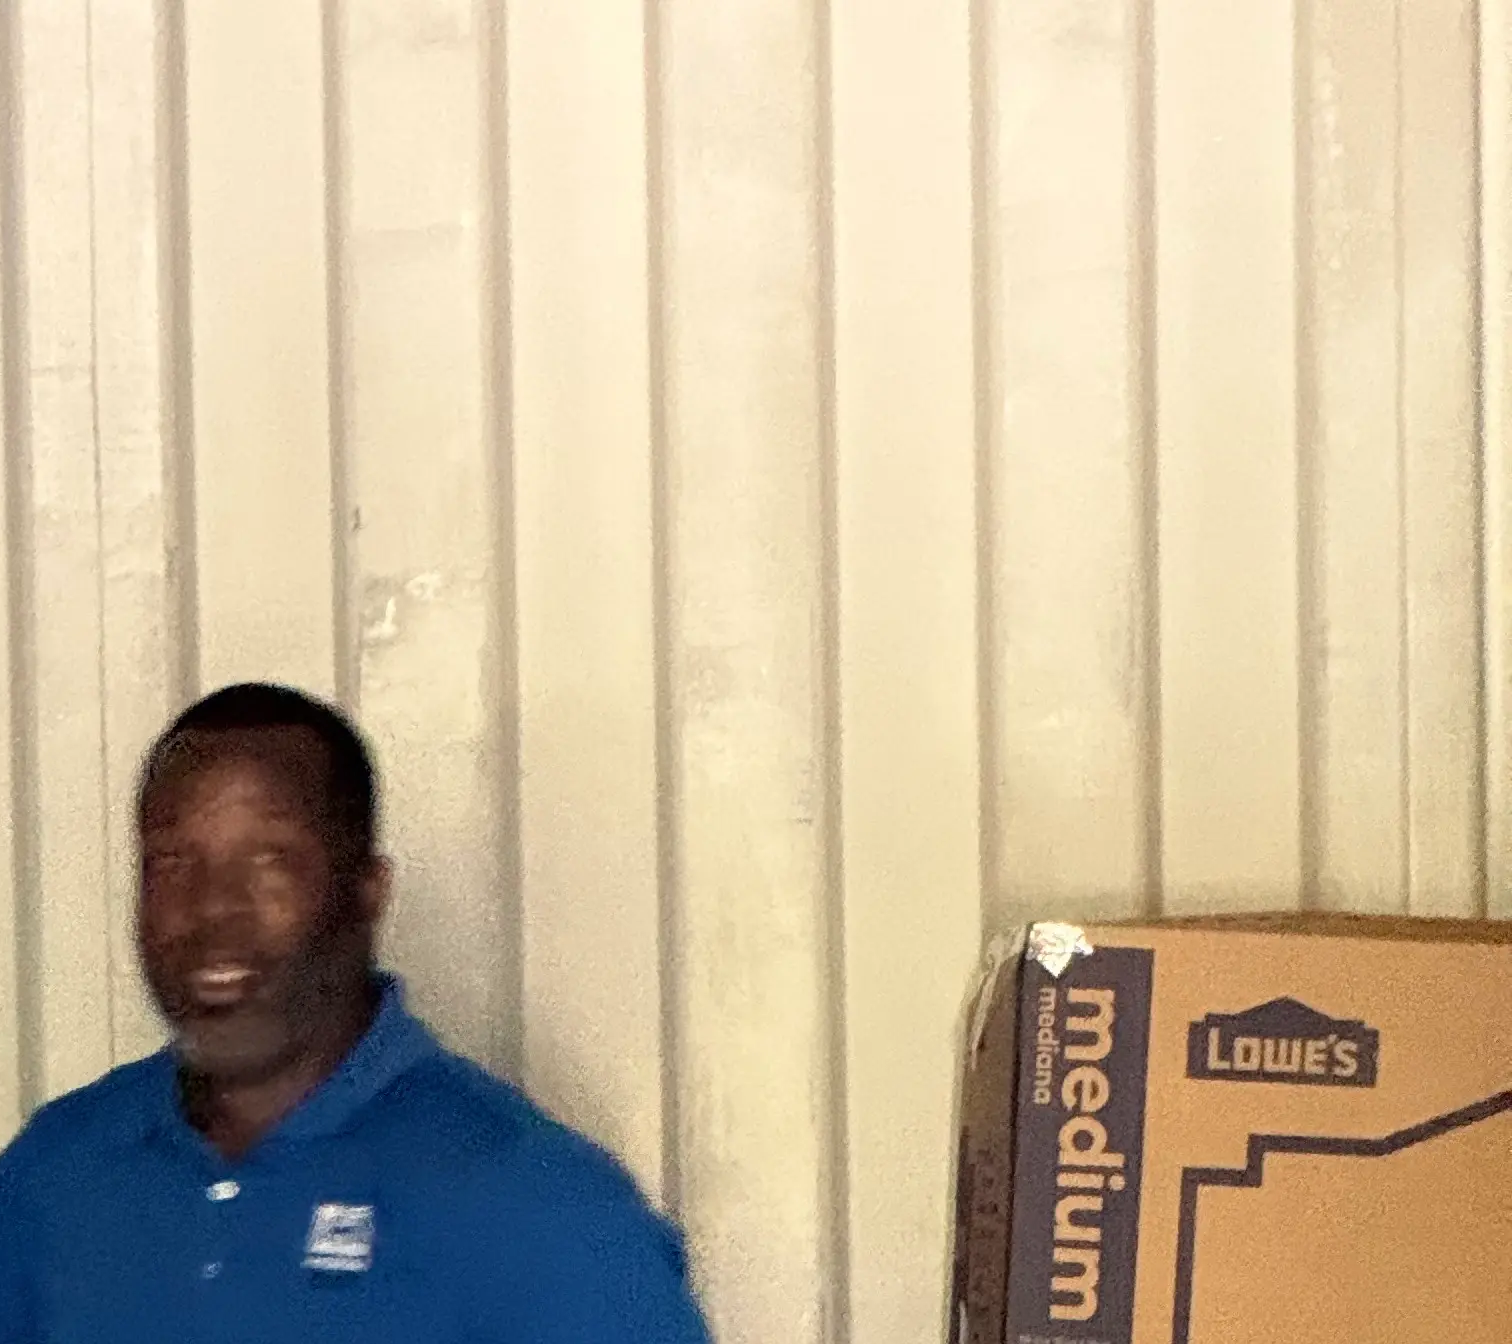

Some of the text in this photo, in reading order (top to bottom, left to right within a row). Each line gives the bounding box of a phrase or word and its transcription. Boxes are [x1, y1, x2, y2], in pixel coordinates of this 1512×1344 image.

[1033, 986, 1061, 1104] mediana
[1207, 1028, 1358, 1077] LOWE'S
[1048, 987, 1127, 1322] medium
